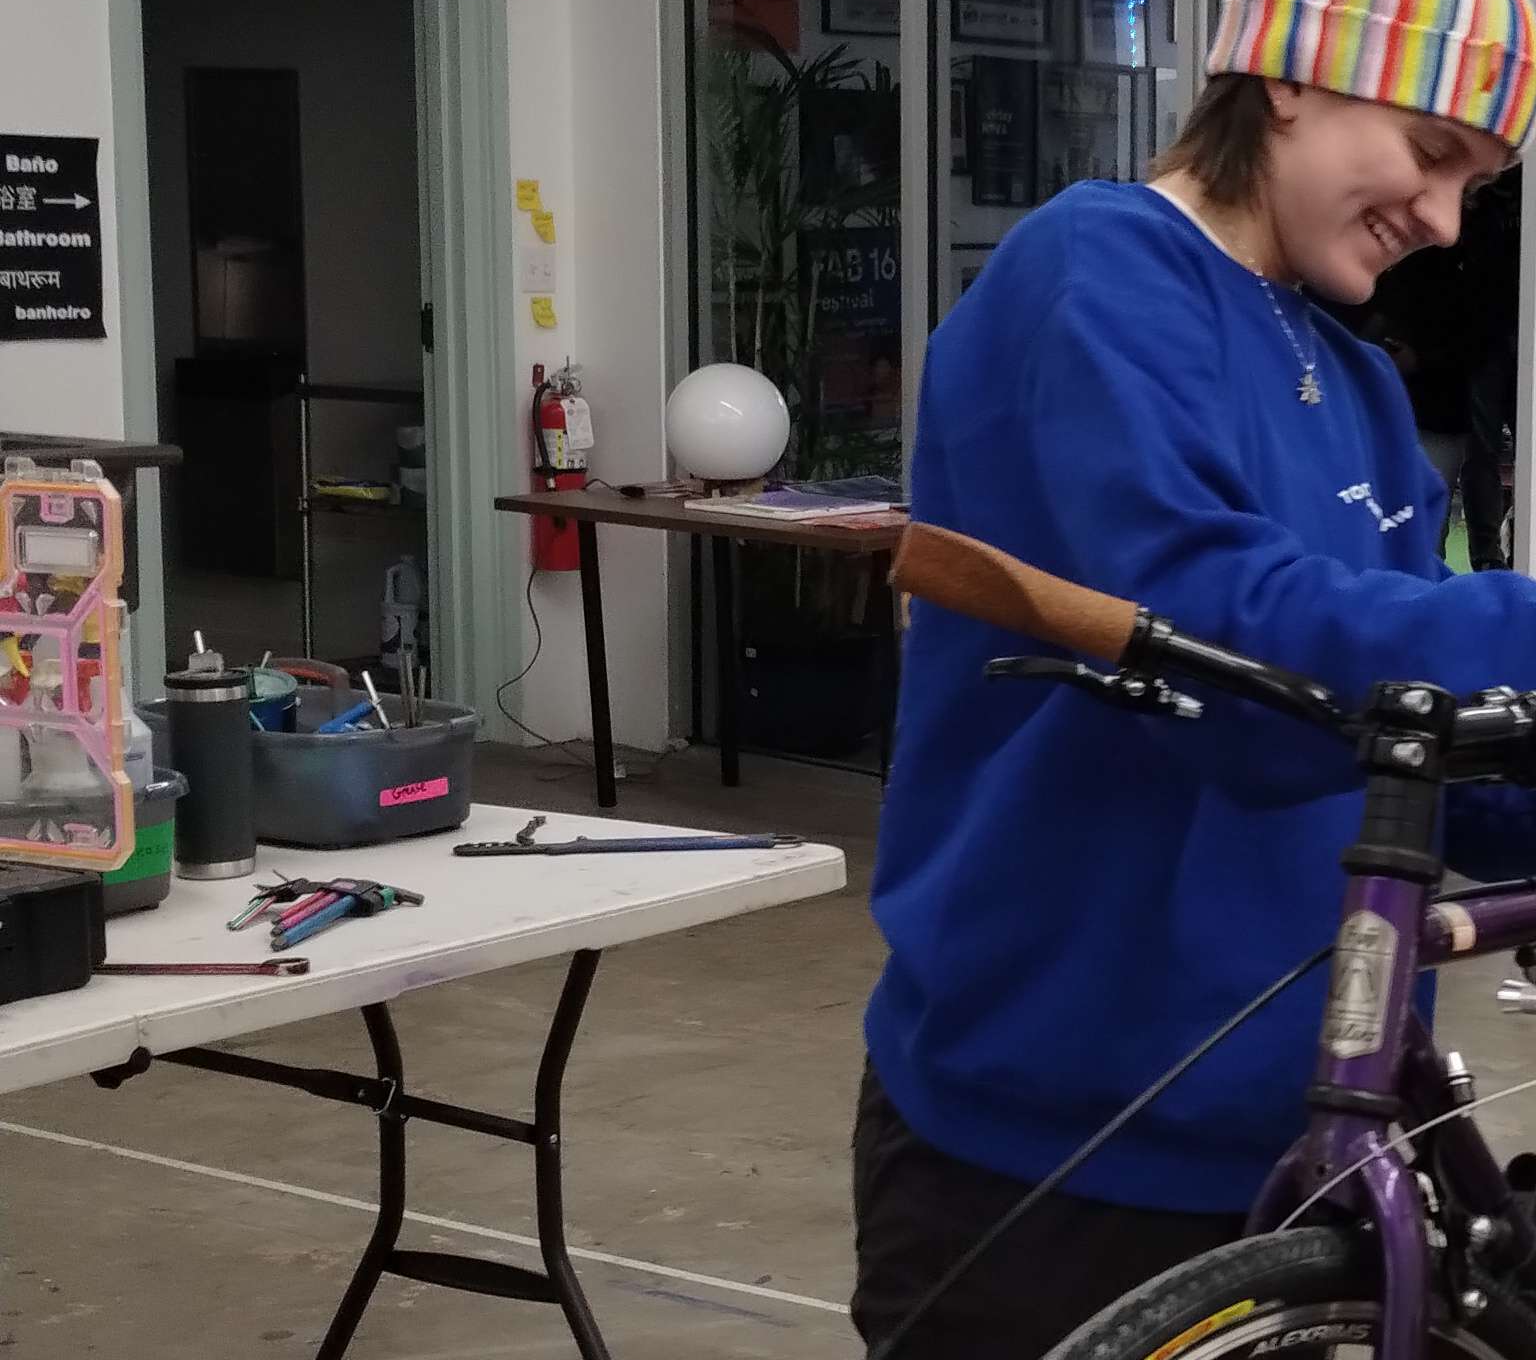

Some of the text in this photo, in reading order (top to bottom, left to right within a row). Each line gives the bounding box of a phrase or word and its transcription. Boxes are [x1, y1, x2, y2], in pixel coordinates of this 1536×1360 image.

[5, 154, 59, 173] Baño
[0, 229, 92, 247] athroom
[869, 247, 897, 281] 16
[15, 305, 92, 321] banheiro
